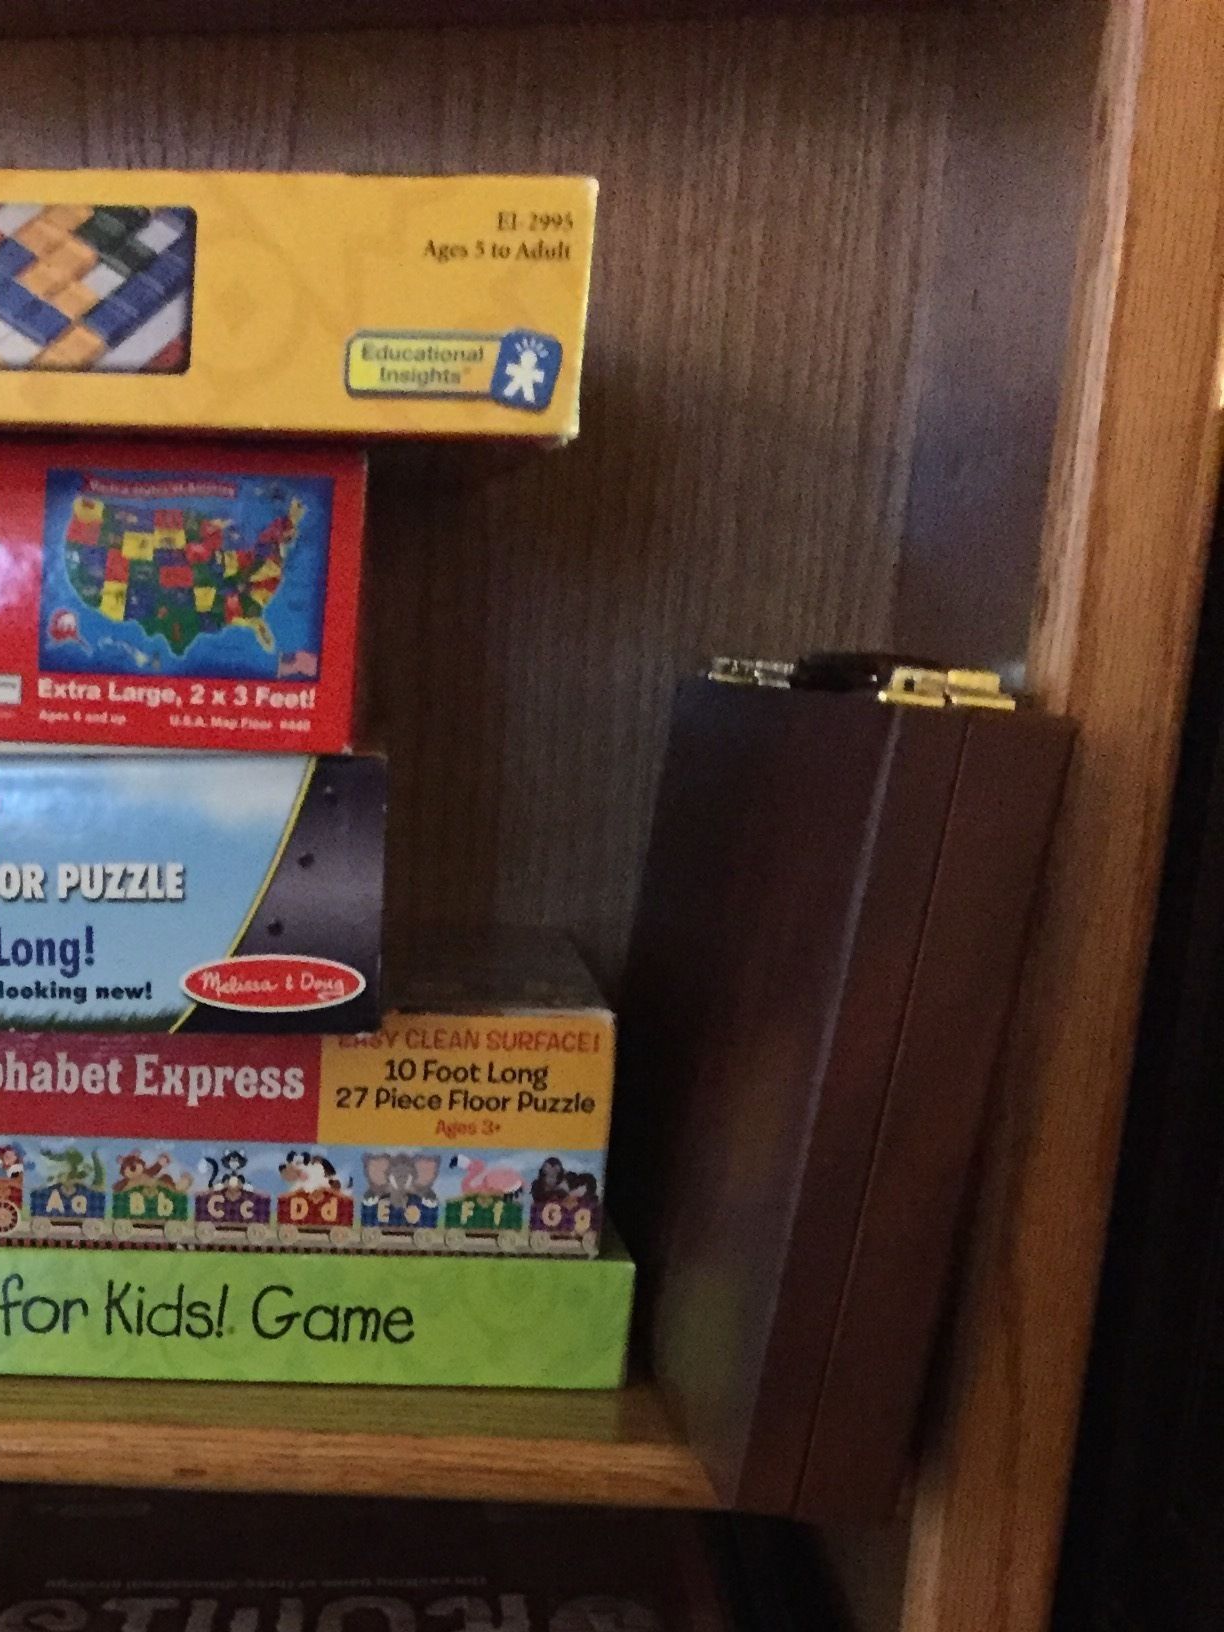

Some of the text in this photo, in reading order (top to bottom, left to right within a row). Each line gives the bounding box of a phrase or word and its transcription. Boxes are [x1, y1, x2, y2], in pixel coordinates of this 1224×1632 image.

[423, 238, 571, 262] Ages to Adult
[361, 343, 484, 364] Educational
[379, 366, 462, 387] Insights
[38, 677, 101, 701] Extra
[108, 682, 183, 709] Large,
[189, 684, 205, 704] 2
[211, 689, 227, 706] x
[233, 686, 248, 706] 3
[255, 687, 317, 710] Feet!
[57, 862, 186, 902] PUZZLE
[95, 981, 154, 1001] new!
[199, 970, 346, 1002] Melissa Doug
[405, 1028, 480, 1051] CLEAN
[486, 1030, 602, 1053] SURFACE!
[134, 1053, 306, 1107] Express
[383, 1058, 550, 1092] 10 Foot Long
[335, 1087, 597, 1115] 27 Piece Floor Puzzle
[435, 1119, 503, 1139] Ages 3+
[206, 1197, 226, 1220] C
[289, 1198, 338, 1223] D d
[0, 1273, 89, 1337] for
[104, 1278, 230, 1339] Kids!
[251, 1283, 415, 1345] Game
